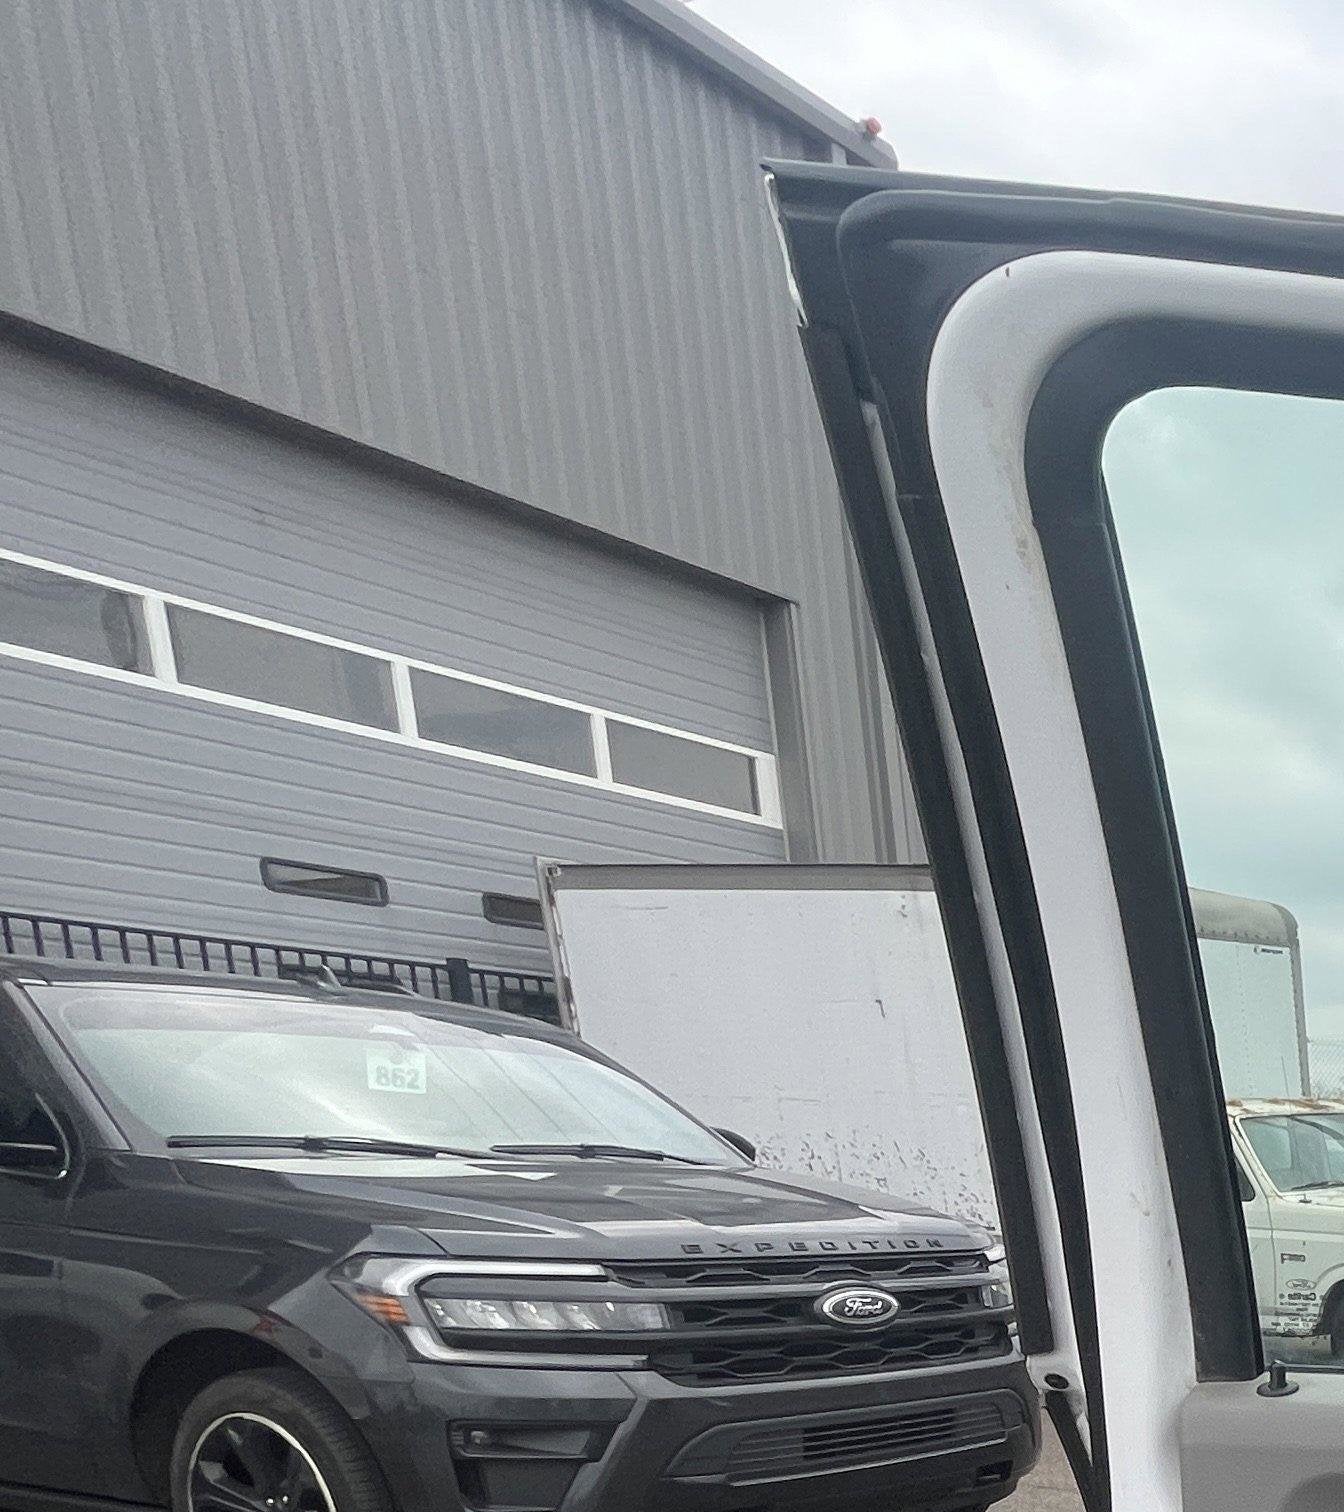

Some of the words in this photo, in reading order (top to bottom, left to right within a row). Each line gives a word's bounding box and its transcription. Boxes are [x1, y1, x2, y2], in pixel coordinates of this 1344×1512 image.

[376, 1065, 420, 1089] 862
[680, 1239, 944, 1254] EXPEDITION
[844, 1297, 884, 1316] Ford
